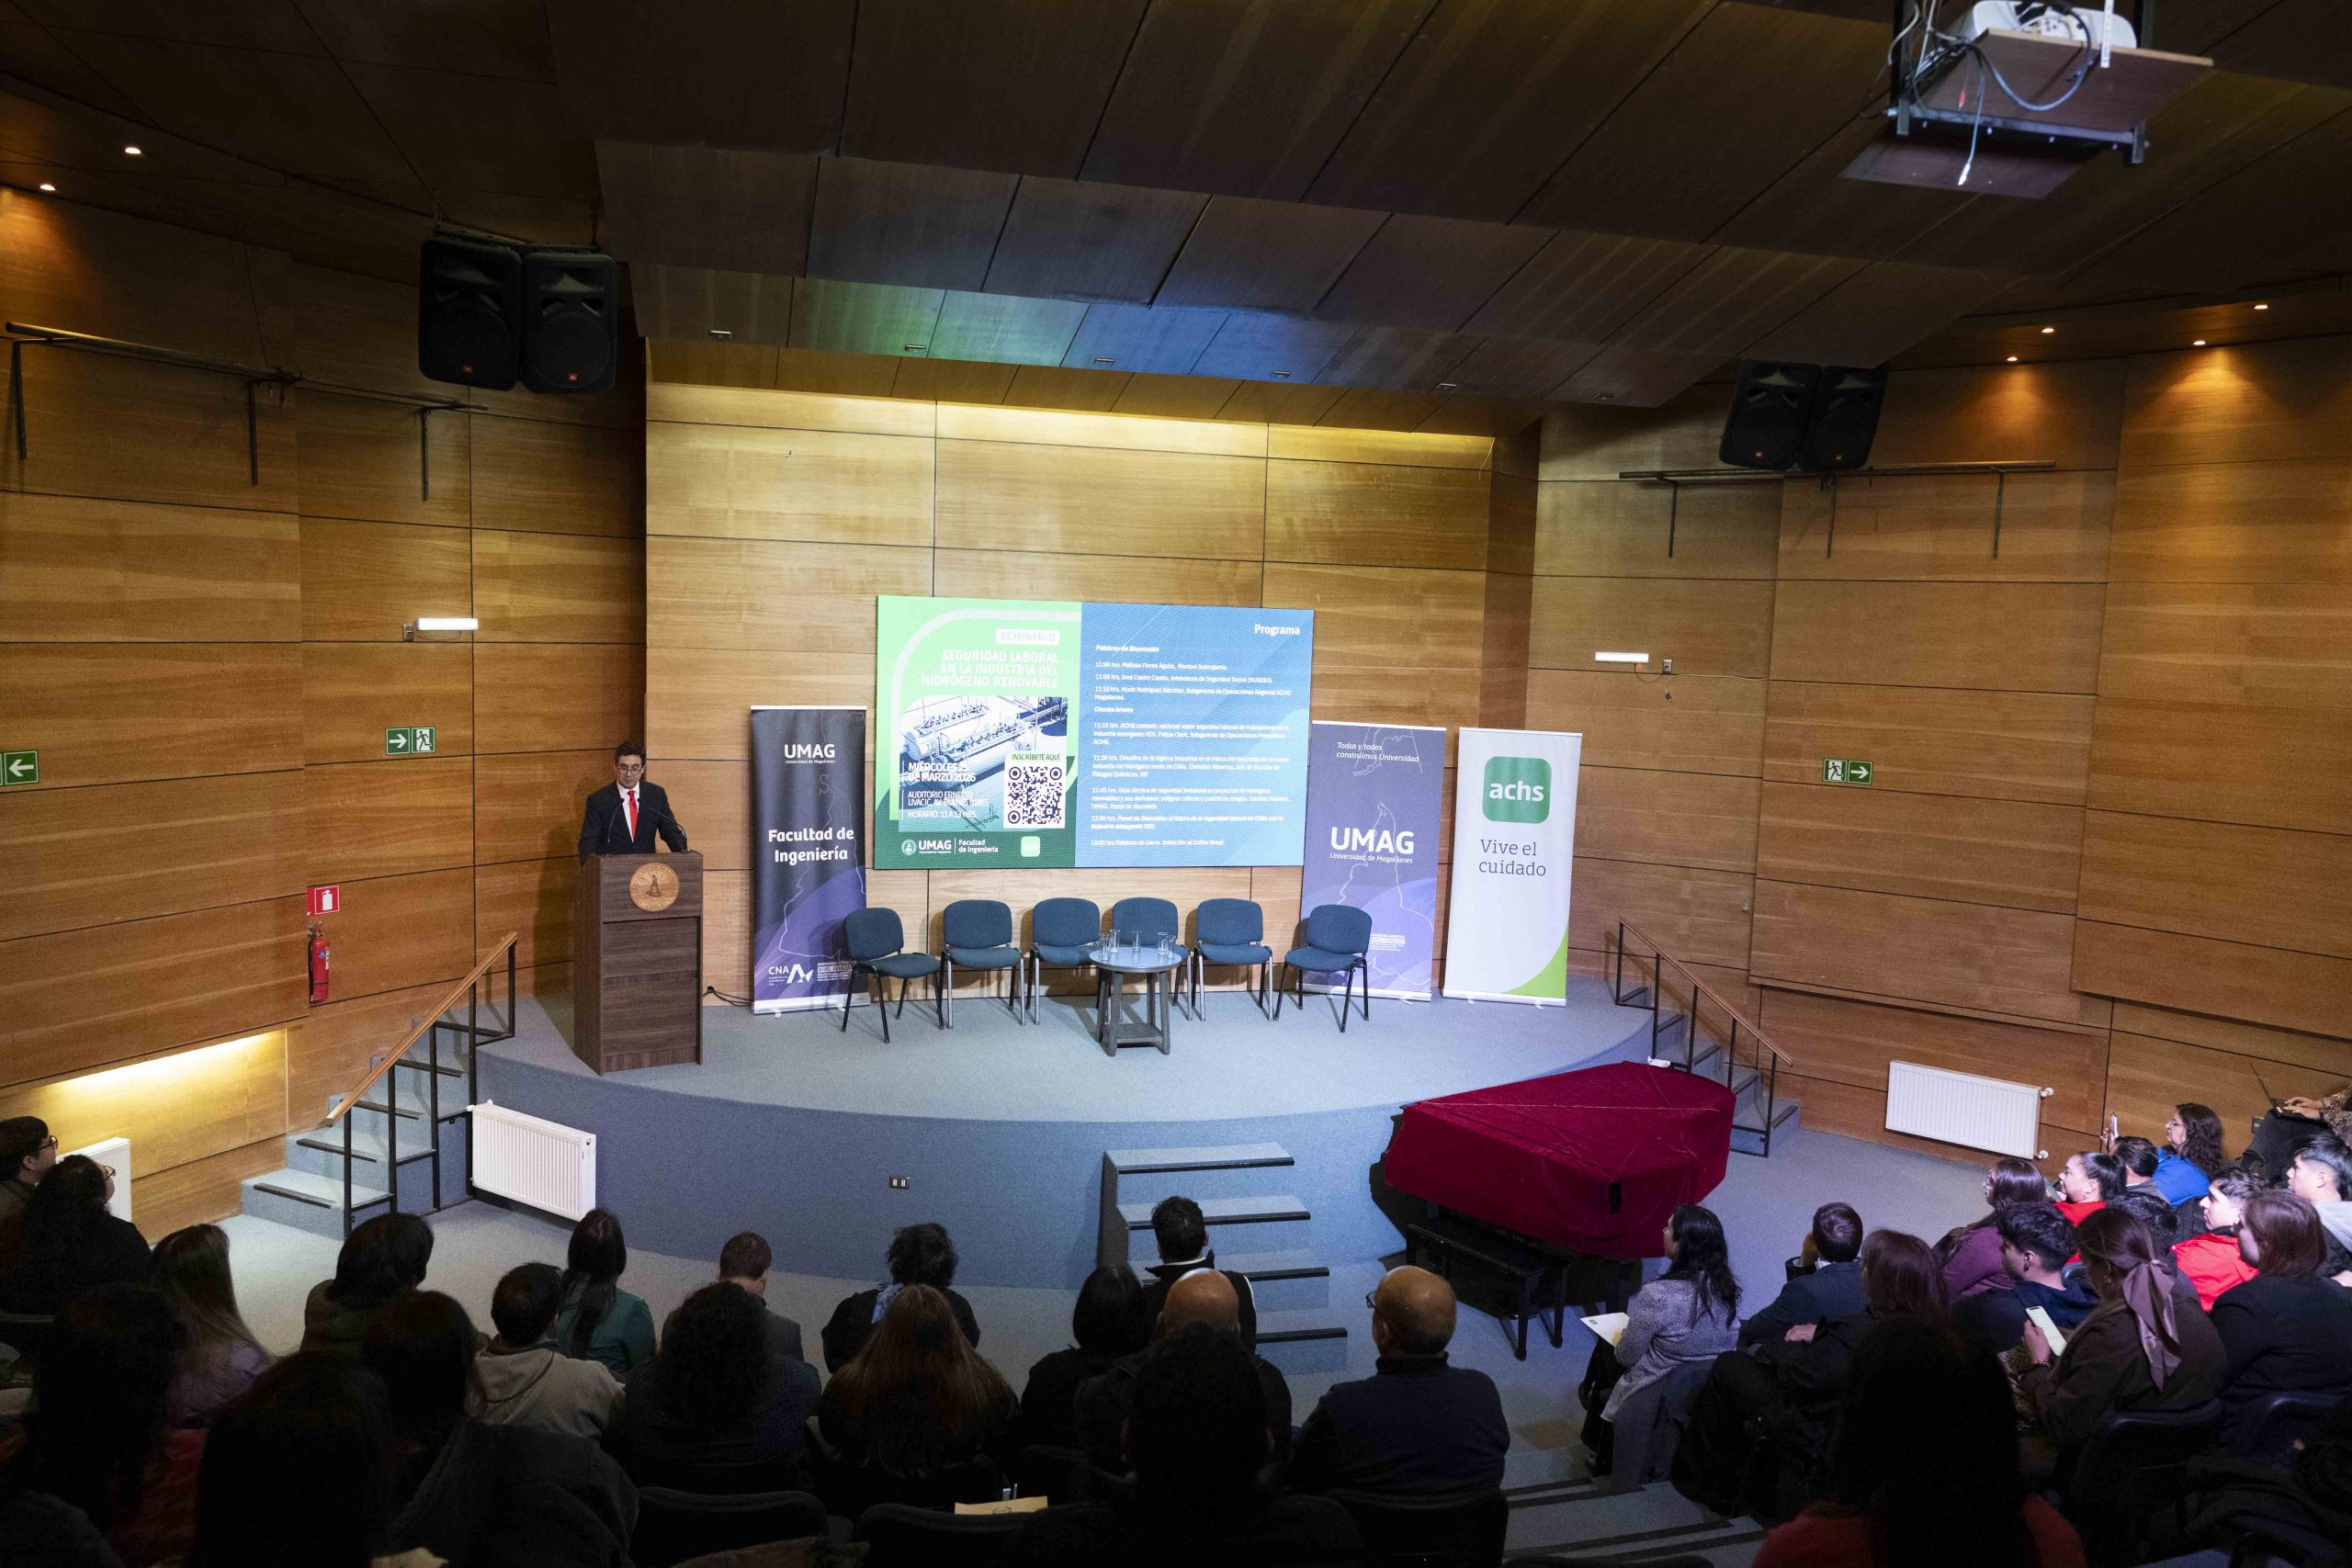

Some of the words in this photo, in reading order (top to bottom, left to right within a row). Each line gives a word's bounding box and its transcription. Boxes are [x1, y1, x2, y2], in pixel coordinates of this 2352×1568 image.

[1001, 632, 1055, 641] SEMINARIO
[1254, 624, 1300, 637] Programa
[942, 650, 1006, 661] SEGURIDAD
[1010, 651, 1058, 663] LABORAL
[941, 662, 956, 673] EN
[960, 663, 971, 674] LA
[976, 663, 1036, 675] INDUSTRIA
[1039, 665, 1058, 676] DEL
[922, 673, 990, 686] HIDRÓGENO
[994, 677, 1059, 687] RENOVABLE
[784, 744, 835, 758] UMAG
[1337, 751, 1377, 760] construimos
[1379, 754, 1419, 762] Universidad
[922, 773, 953, 781] MARZO
[955, 773, 976, 781] 2026
[1489, 780, 1544, 801] achs
[768, 828, 832, 842] Facultad
[837, 827, 854, 840] de
[1331, 827, 1414, 854] UMAG
[919, 840, 951, 850] UMAG
[1480, 839, 1518, 855] Vive
[1522, 842, 1537, 856] el
[775, 846, 848, 866] Ingeniería
[1330, 852, 1366, 861] Universidad
[1377, 855, 1413, 864] Magallanes
[1479, 860, 1546, 876] cuidado
[769, 965, 789, 975] CNA
